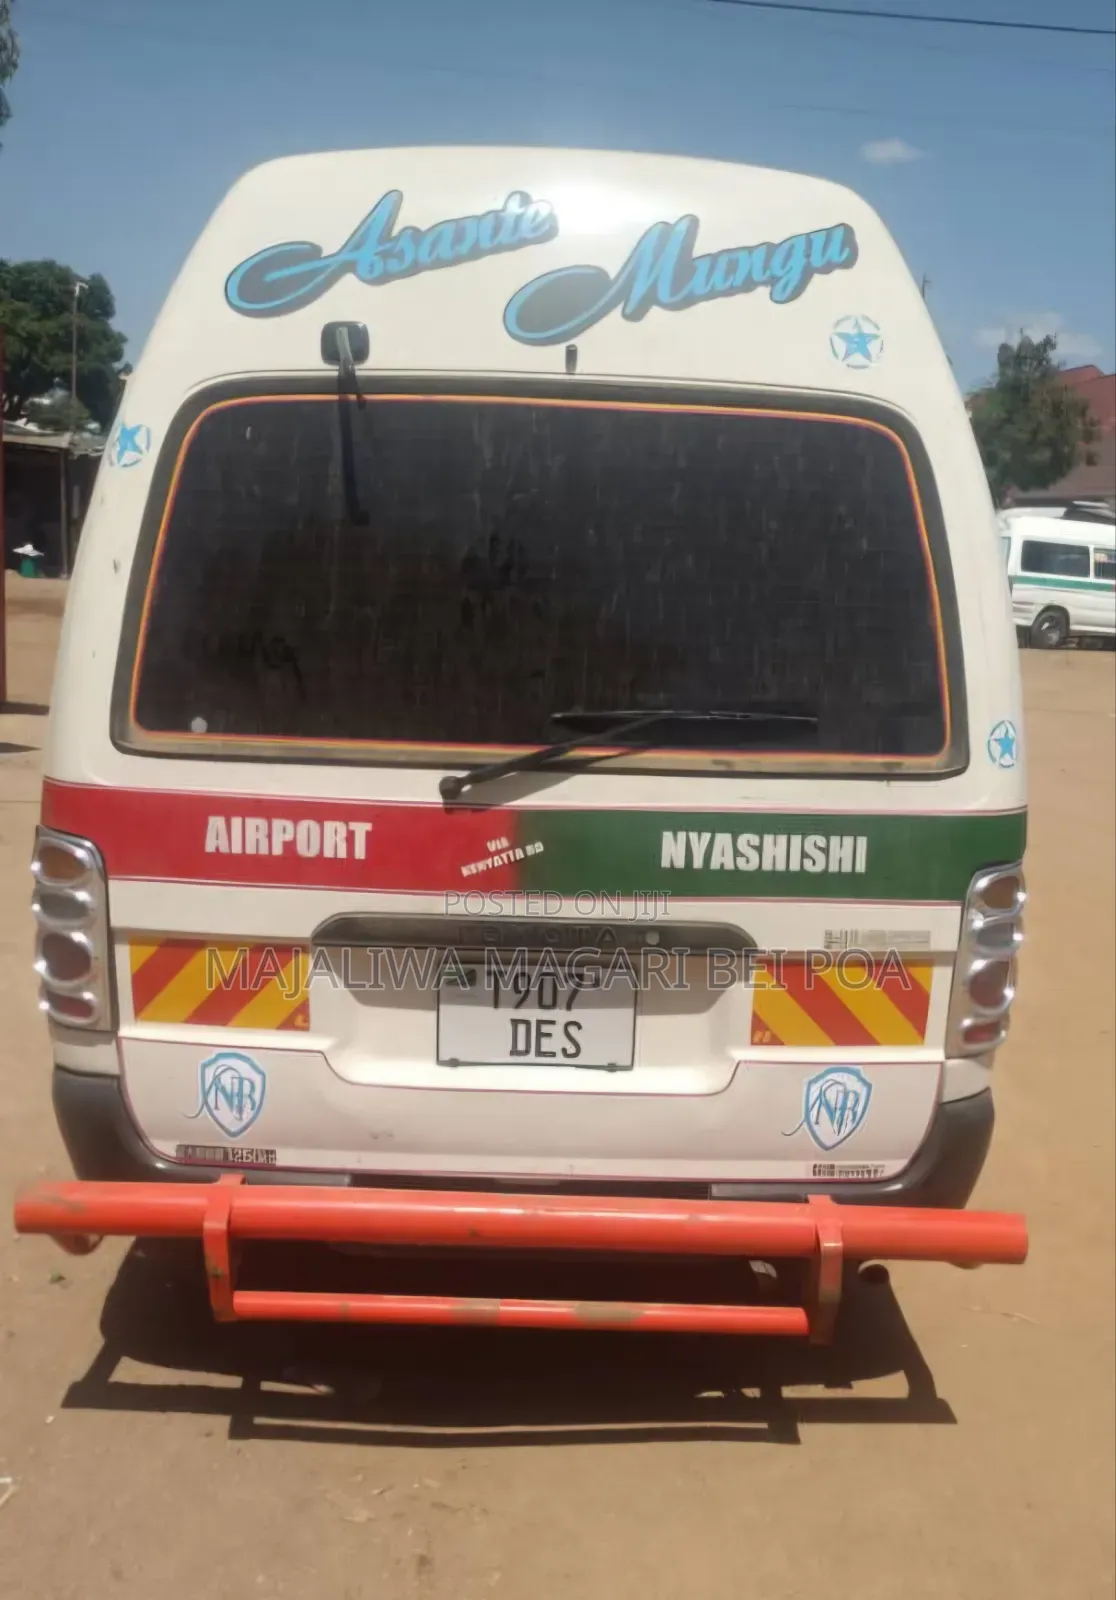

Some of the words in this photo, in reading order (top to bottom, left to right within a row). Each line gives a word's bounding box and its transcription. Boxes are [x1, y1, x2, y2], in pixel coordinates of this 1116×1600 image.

[225, 189, 559, 318] Asante
[503, 213, 858, 346] Mungu
[204, 815, 373, 861] AIRPORT
[661, 830, 868, 874] NYASHISHI
[457, 924, 618, 947] OOTA
[510, 1018, 583, 1058] DES
